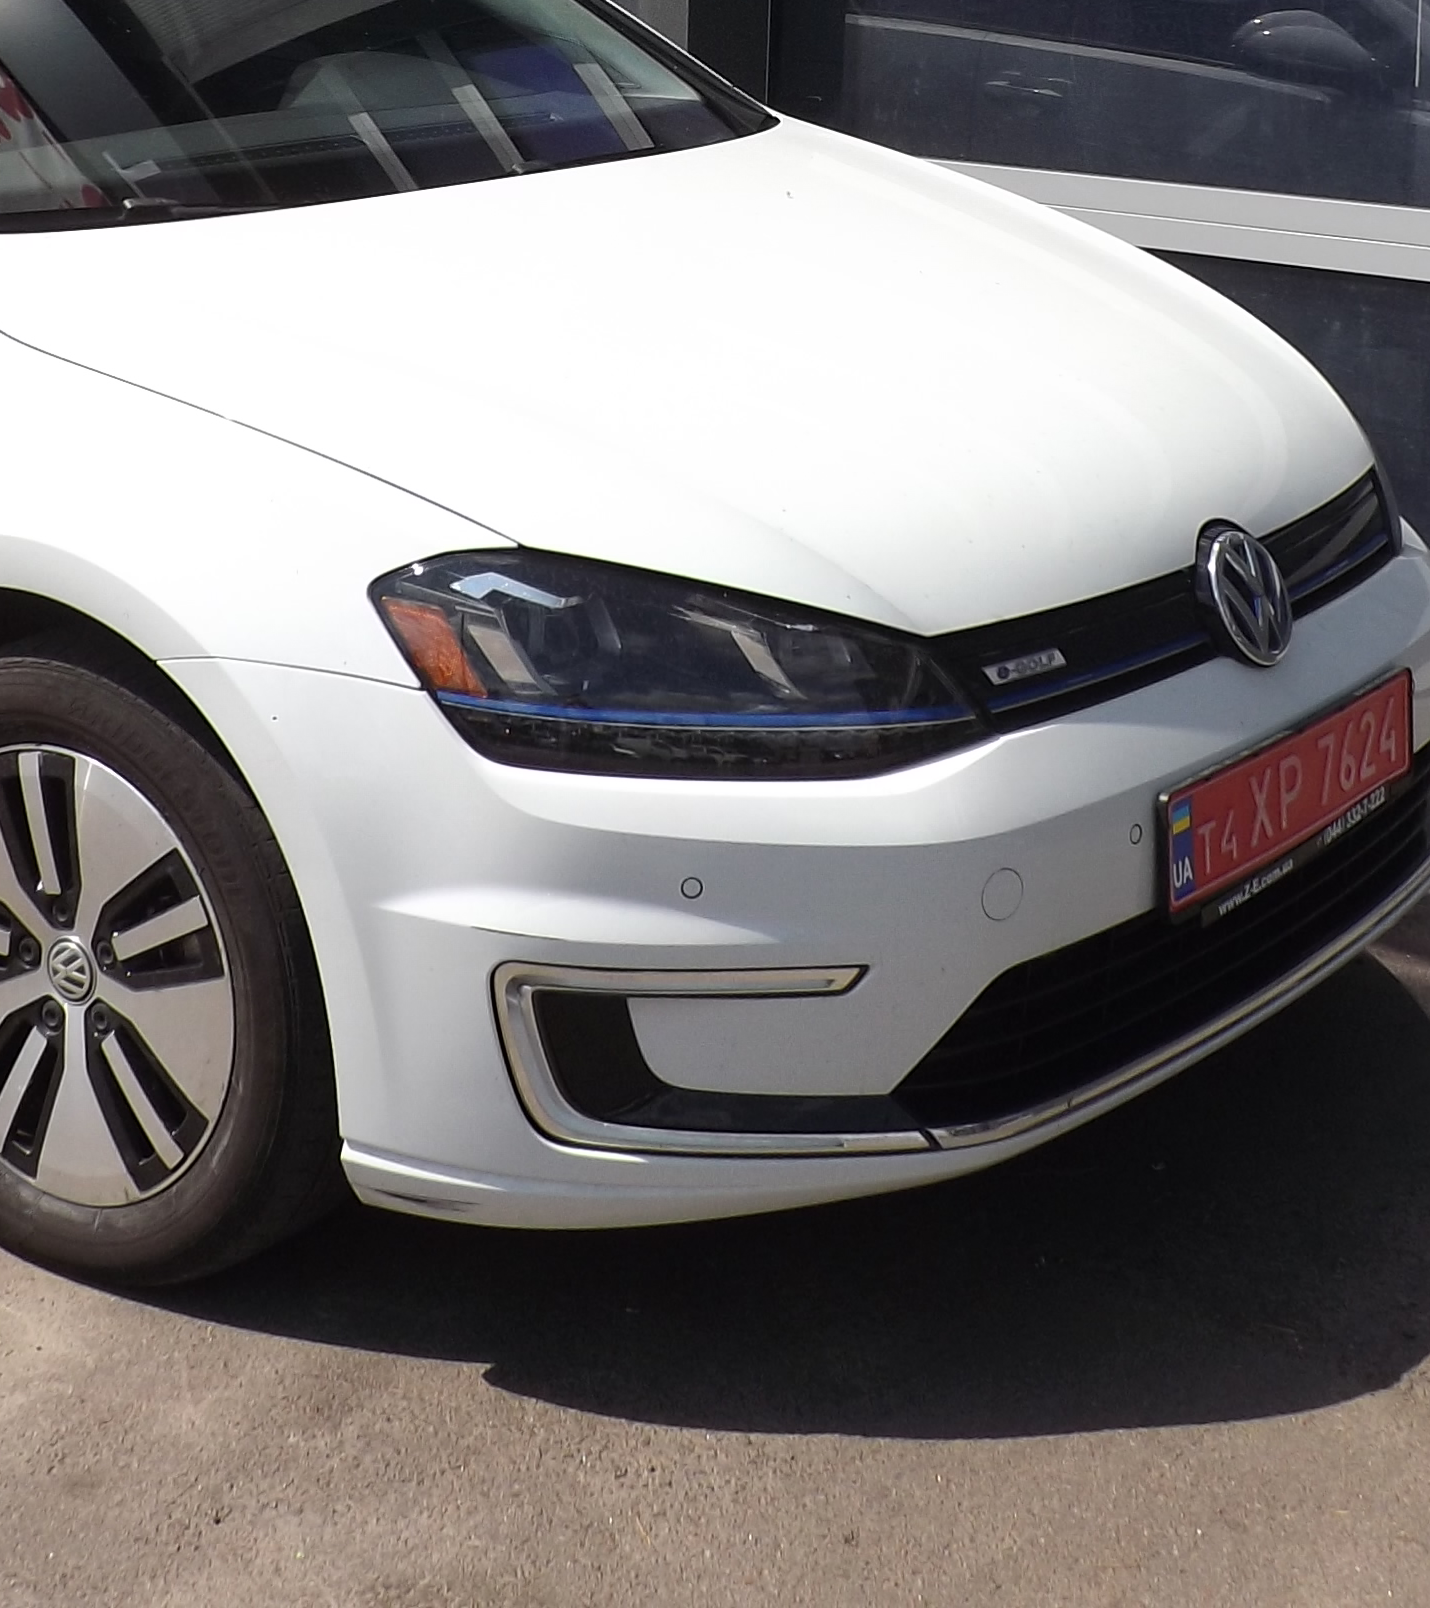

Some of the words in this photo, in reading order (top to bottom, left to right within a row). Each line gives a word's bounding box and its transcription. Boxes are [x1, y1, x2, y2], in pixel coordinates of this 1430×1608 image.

[1197, 808, 1238, 876] T4
[1248, 753, 1304, 849] XP
[1316, 695, 1397, 806] 7624
[1173, 855, 1194, 890] UA
